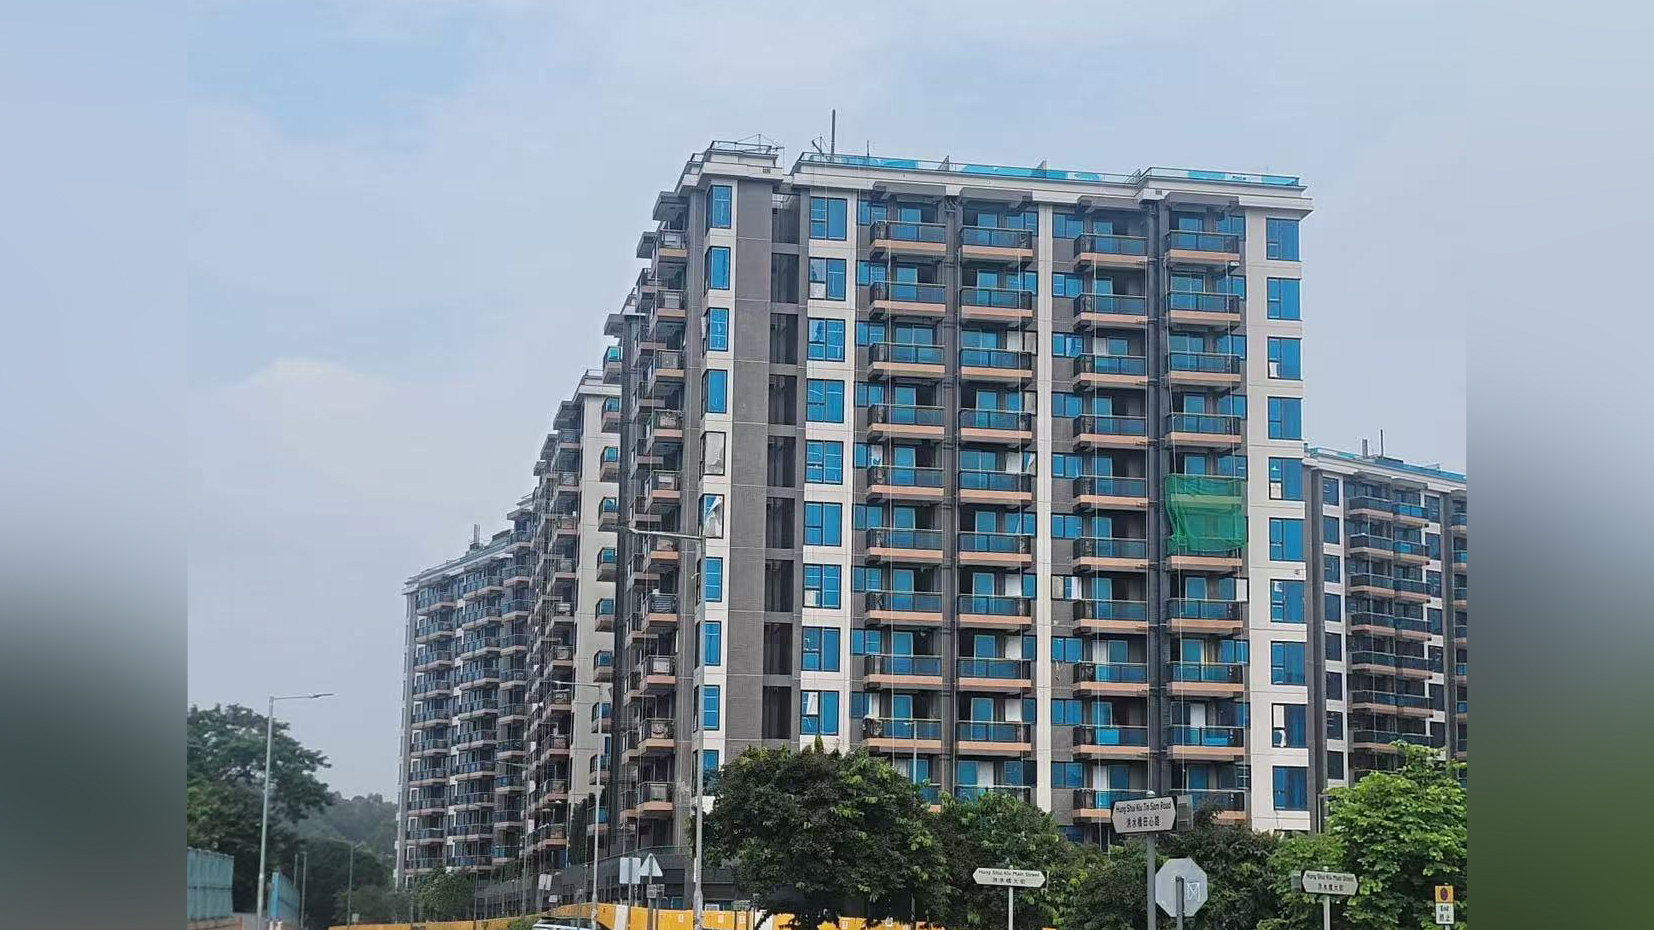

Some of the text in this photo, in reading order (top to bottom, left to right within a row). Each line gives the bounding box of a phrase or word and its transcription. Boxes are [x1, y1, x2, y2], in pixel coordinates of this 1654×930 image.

[1116, 804, 1126, 814] Hung
[1127, 804, 1135, 812] Shui
[1160, 800, 1171, 810] Road
